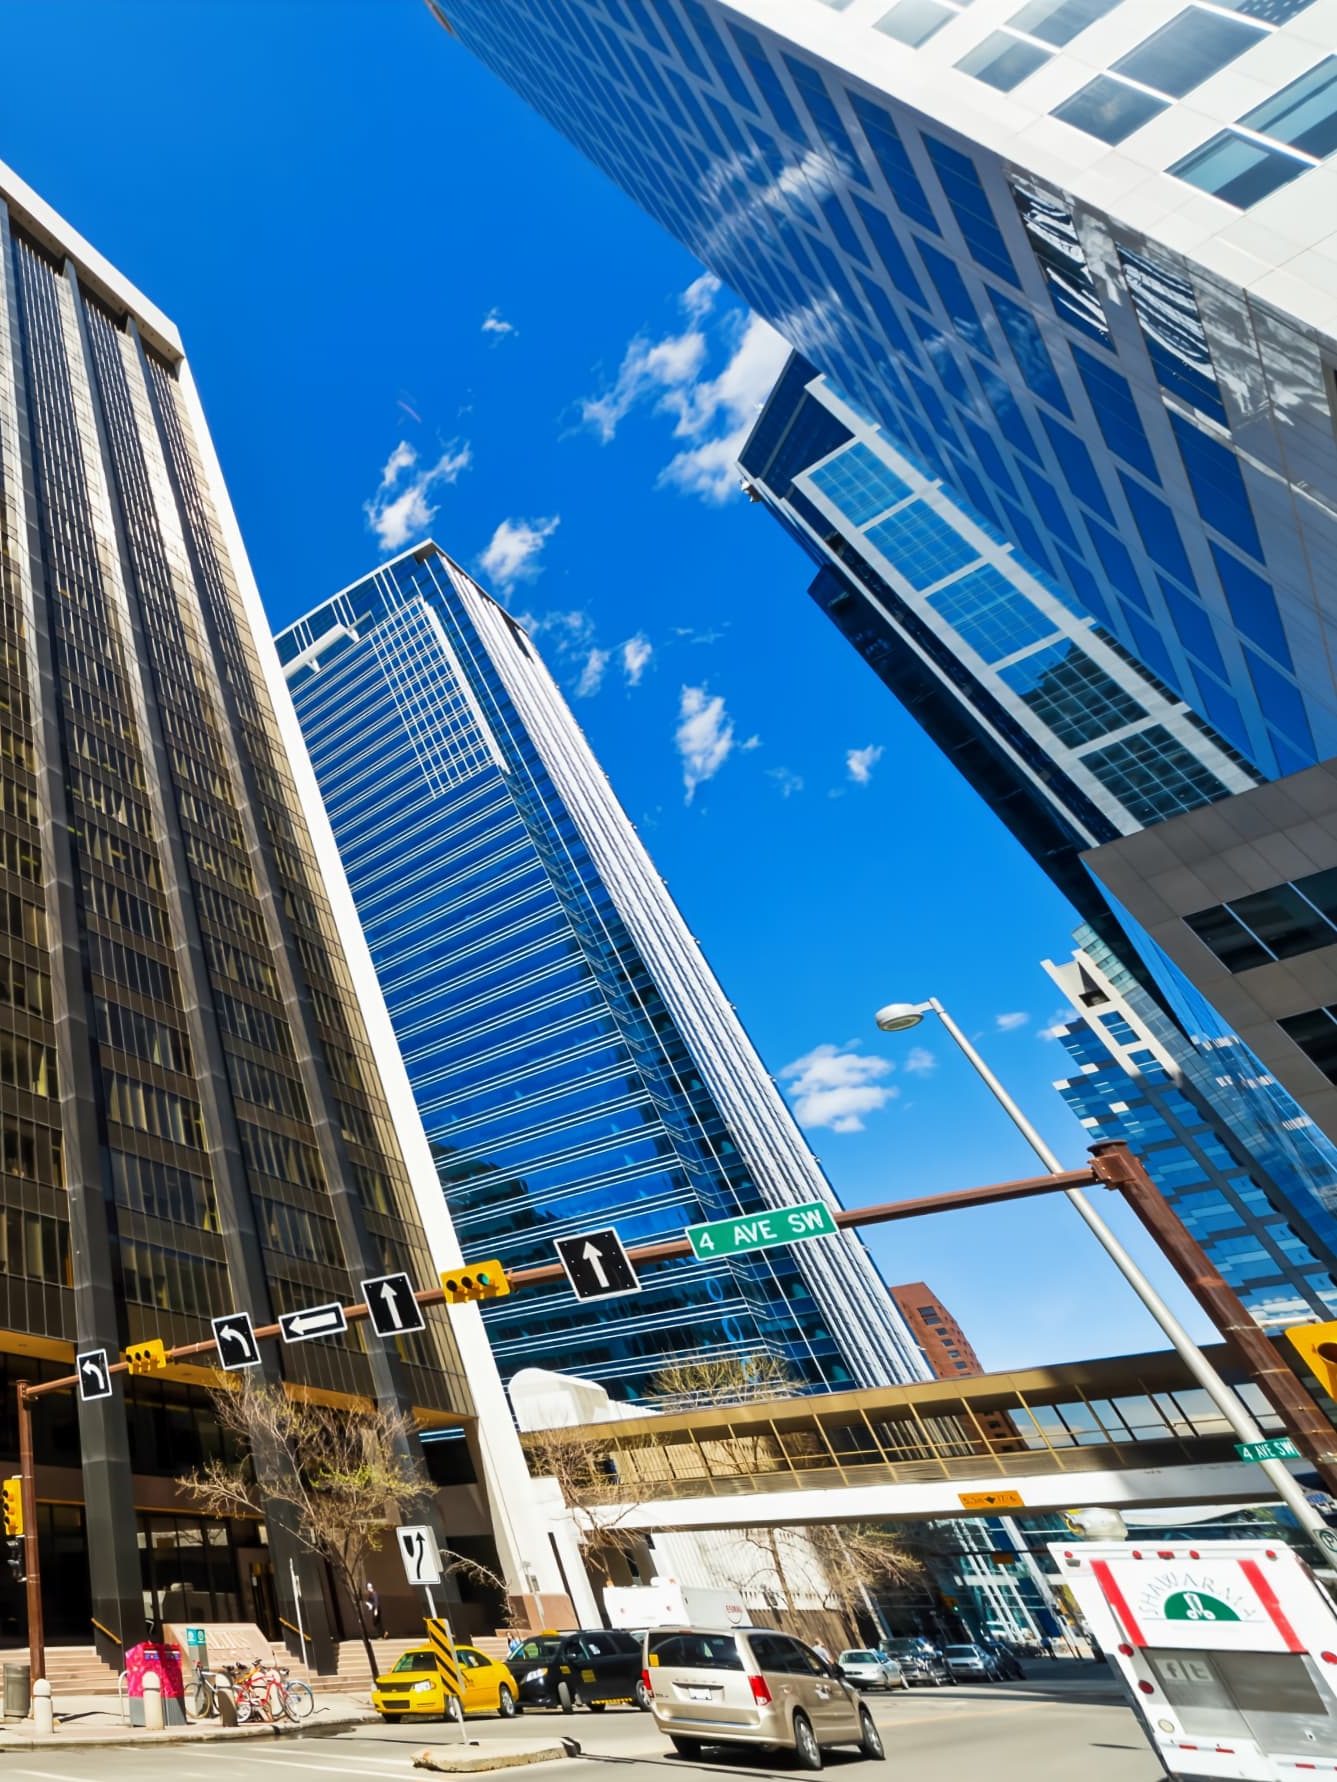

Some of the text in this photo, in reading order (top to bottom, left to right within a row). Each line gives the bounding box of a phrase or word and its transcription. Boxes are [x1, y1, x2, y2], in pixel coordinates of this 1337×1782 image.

[699, 1208, 825, 1251] 4 AVE SW
[1243, 1440, 1296, 1460] 4 AVE SW
